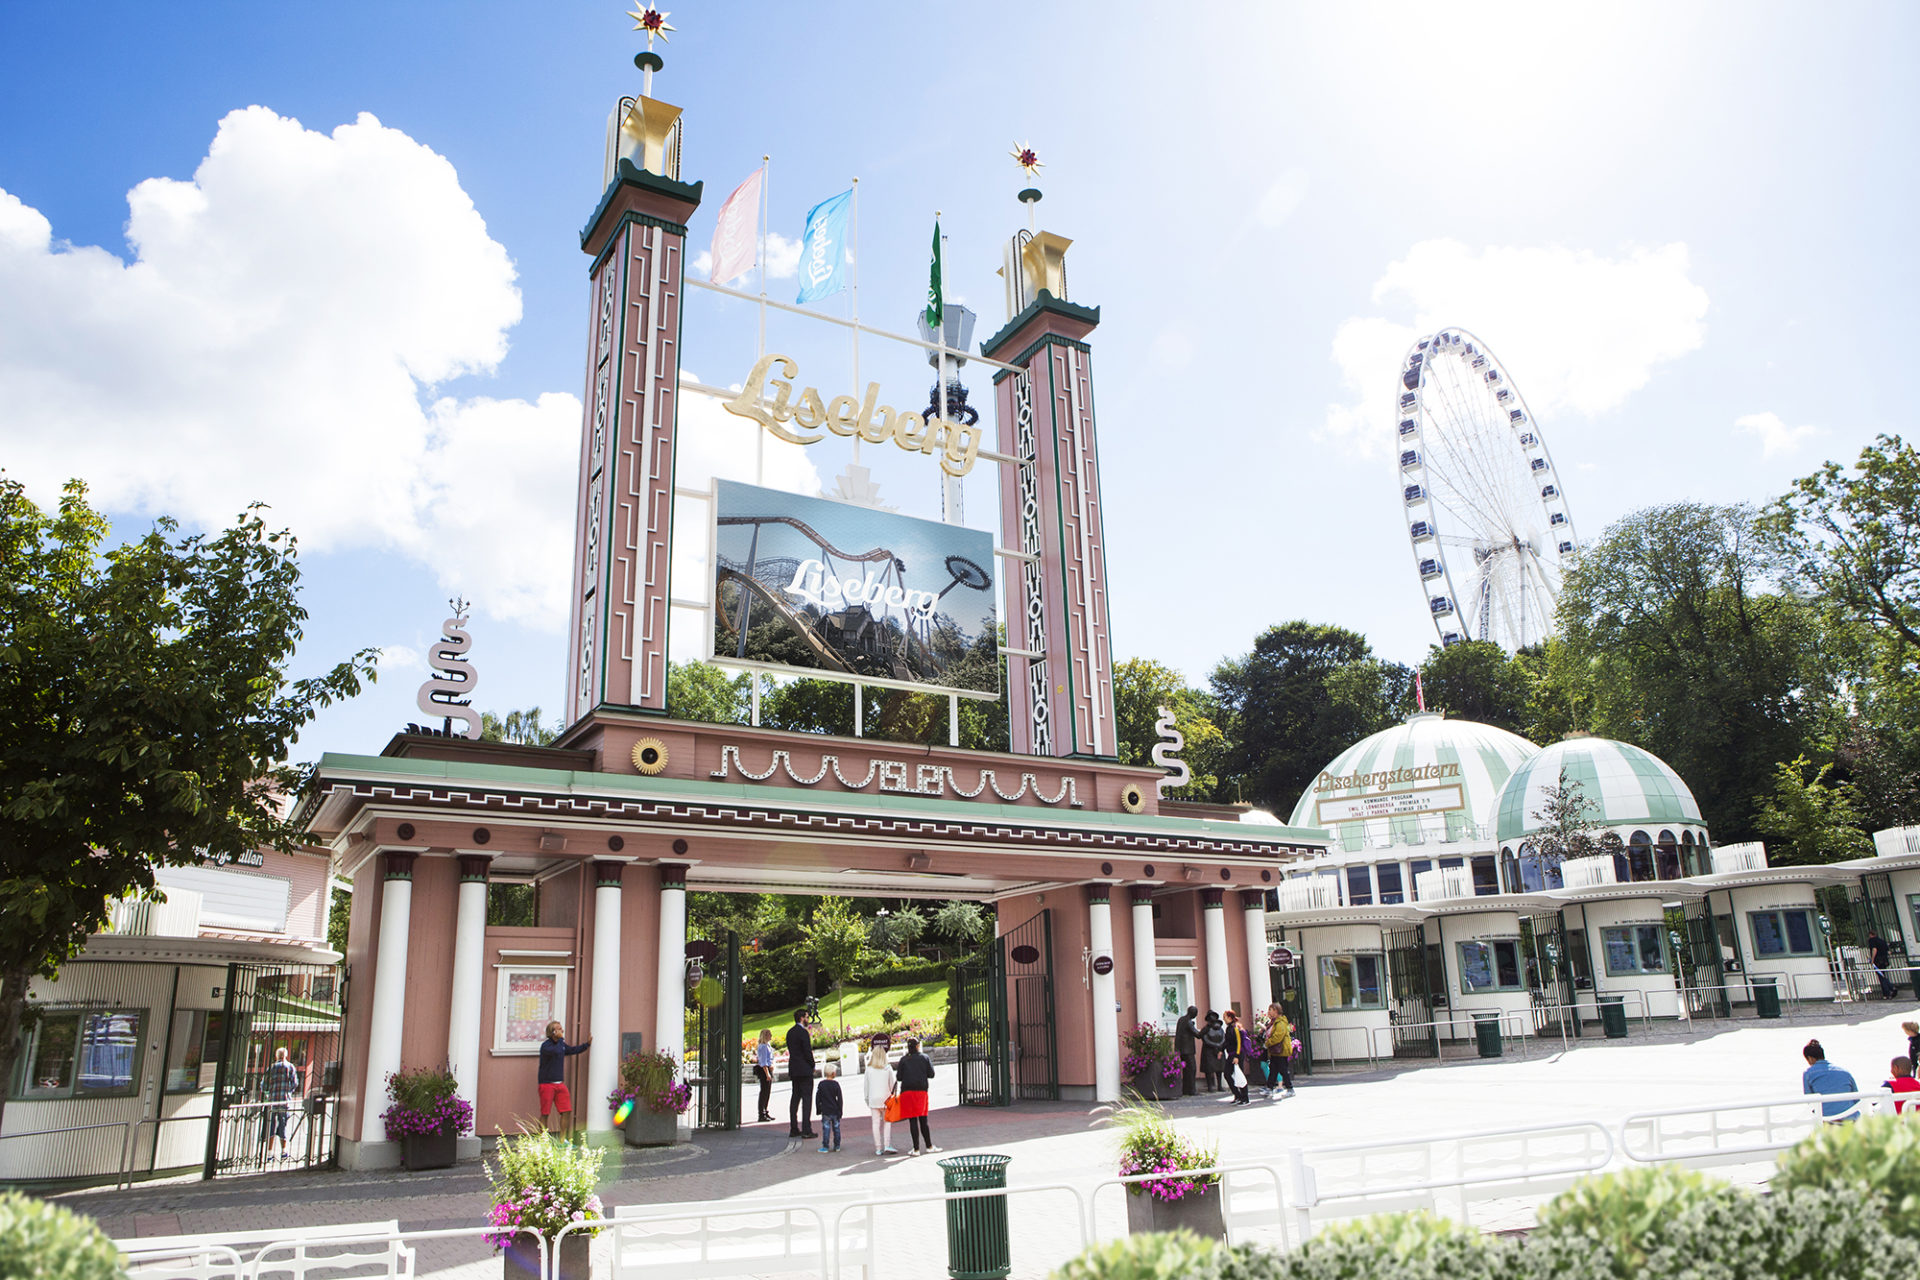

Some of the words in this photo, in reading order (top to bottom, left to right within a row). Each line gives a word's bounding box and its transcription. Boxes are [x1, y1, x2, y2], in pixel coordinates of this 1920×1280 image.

[722, 353, 982, 478] Liseberg
[783, 559, 940, 619] Liseberg
[1313, 763, 1460, 793] Lisebergsteatern
